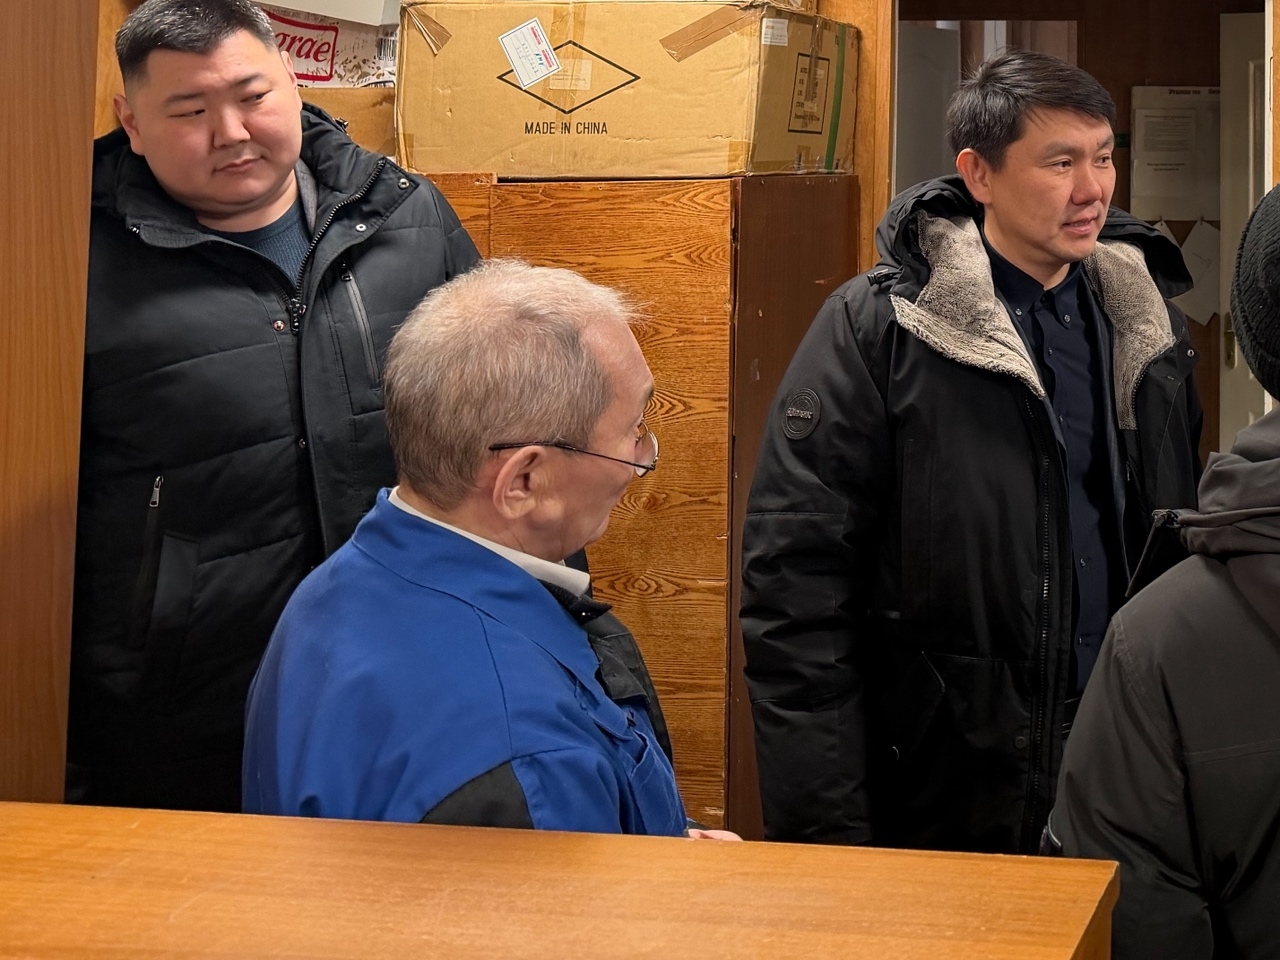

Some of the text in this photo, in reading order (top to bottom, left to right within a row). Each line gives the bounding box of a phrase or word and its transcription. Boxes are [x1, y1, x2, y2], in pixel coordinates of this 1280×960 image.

[524, 122, 608, 135] MADE IN CHINA
